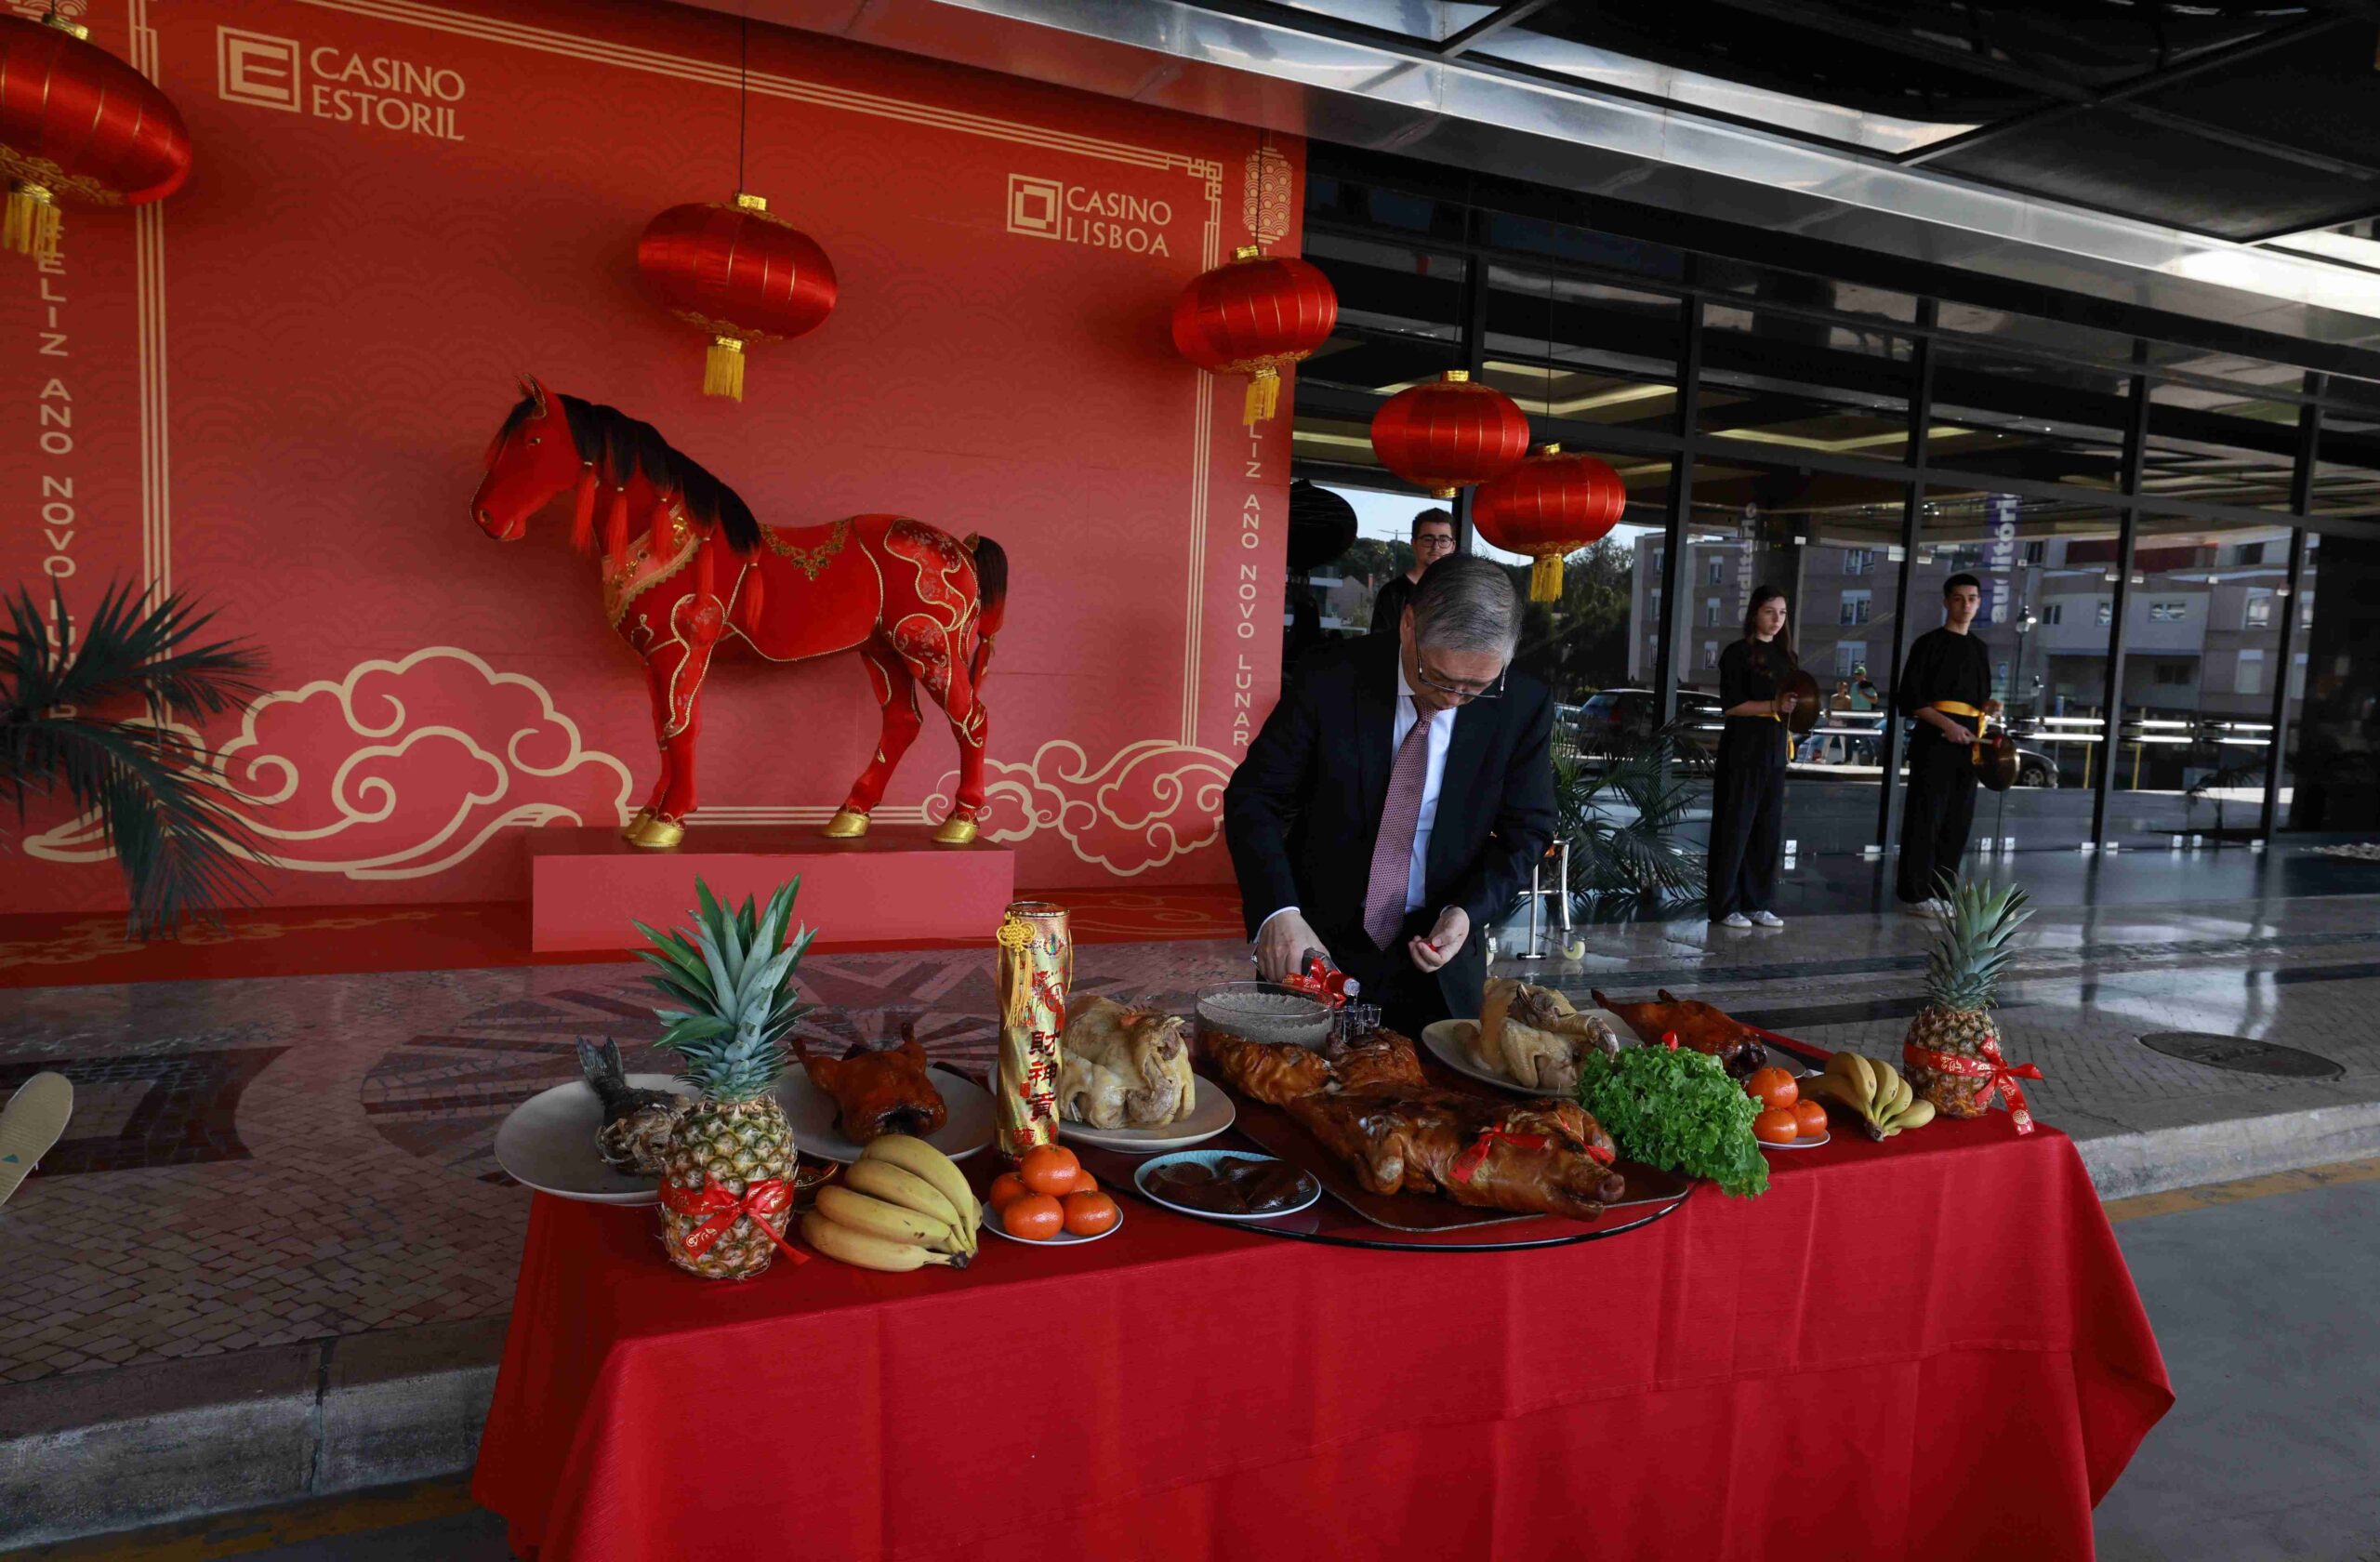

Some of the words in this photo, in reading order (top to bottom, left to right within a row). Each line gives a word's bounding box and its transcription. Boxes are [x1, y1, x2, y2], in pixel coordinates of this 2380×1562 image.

[311, 46, 466, 101] CASINO
[312, 86, 466, 141] ESTORIL
[1066, 185, 1172, 226] CASINO
[1065, 217, 1170, 258] LISBOA
[39, 378, 73, 455] ANO
[42, 475, 76, 578] NOVO
[1241, 494, 1261, 549] ANO
[1236, 564, 1258, 639] NOVO
[1233, 654, 1253, 747] LUNAR
